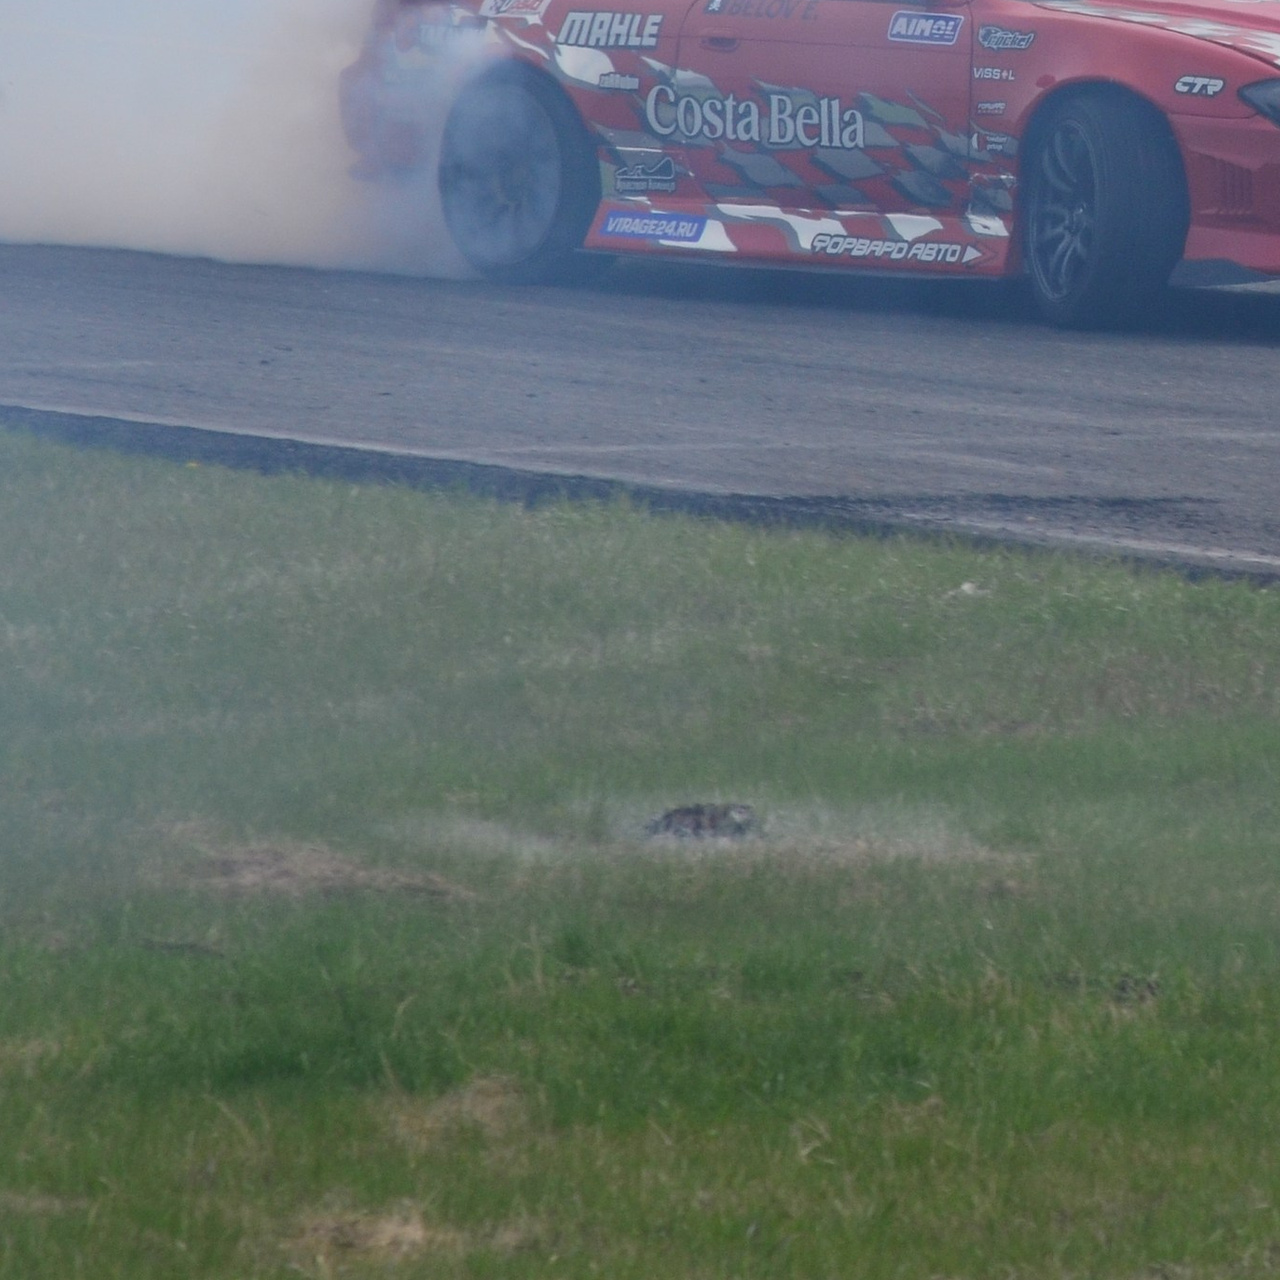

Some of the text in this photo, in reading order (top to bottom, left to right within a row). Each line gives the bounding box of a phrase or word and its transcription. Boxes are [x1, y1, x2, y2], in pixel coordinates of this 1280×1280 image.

[557, 11, 664, 47] MAHLE
[891, 17, 956, 39] AIMOL
[646, 84, 865, 148] Costa Bella
[606, 217, 698, 238] VIRAGE24.RU
[908, 242, 962, 263] АВТО
